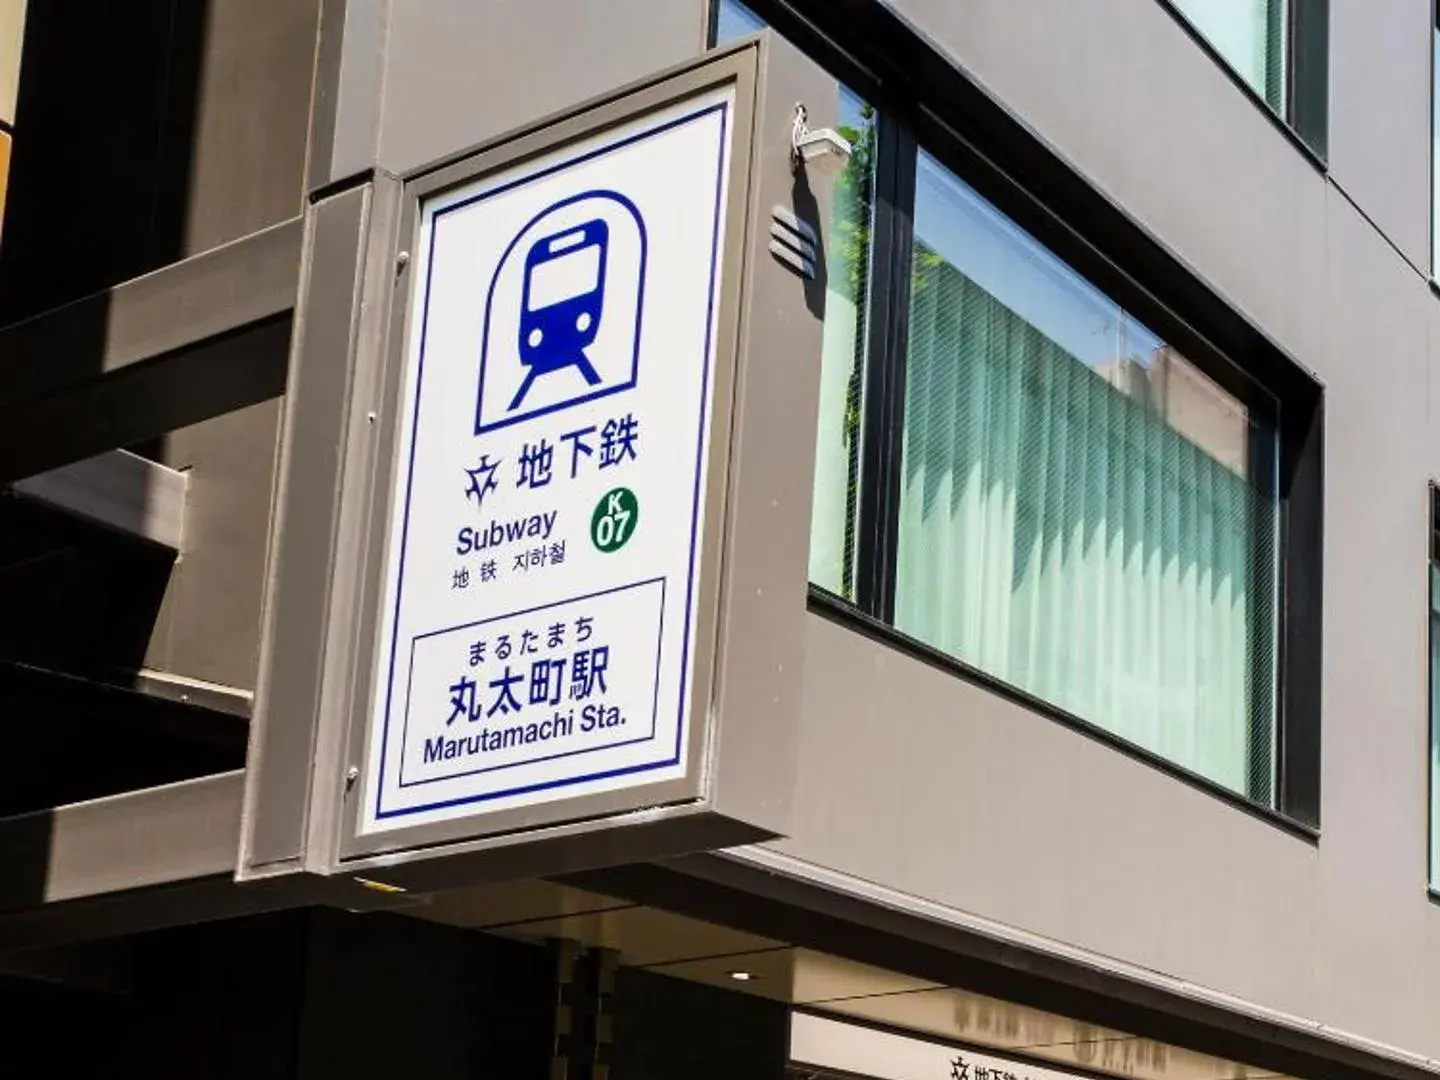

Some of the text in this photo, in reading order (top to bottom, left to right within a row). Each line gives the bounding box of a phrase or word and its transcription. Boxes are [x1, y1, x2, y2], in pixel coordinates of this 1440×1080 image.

[515, 413, 639, 489] 地下鉄
[607, 491, 623, 514] K
[456, 510, 557, 555] Subway
[596, 510, 631, 546] 07
[512, 539, 566, 572] 지하철
[469, 615, 595, 667] まるたまち
[446, 645, 610, 727] 丸太町駅
[423, 703, 626, 764] Marutamachi Sta.
